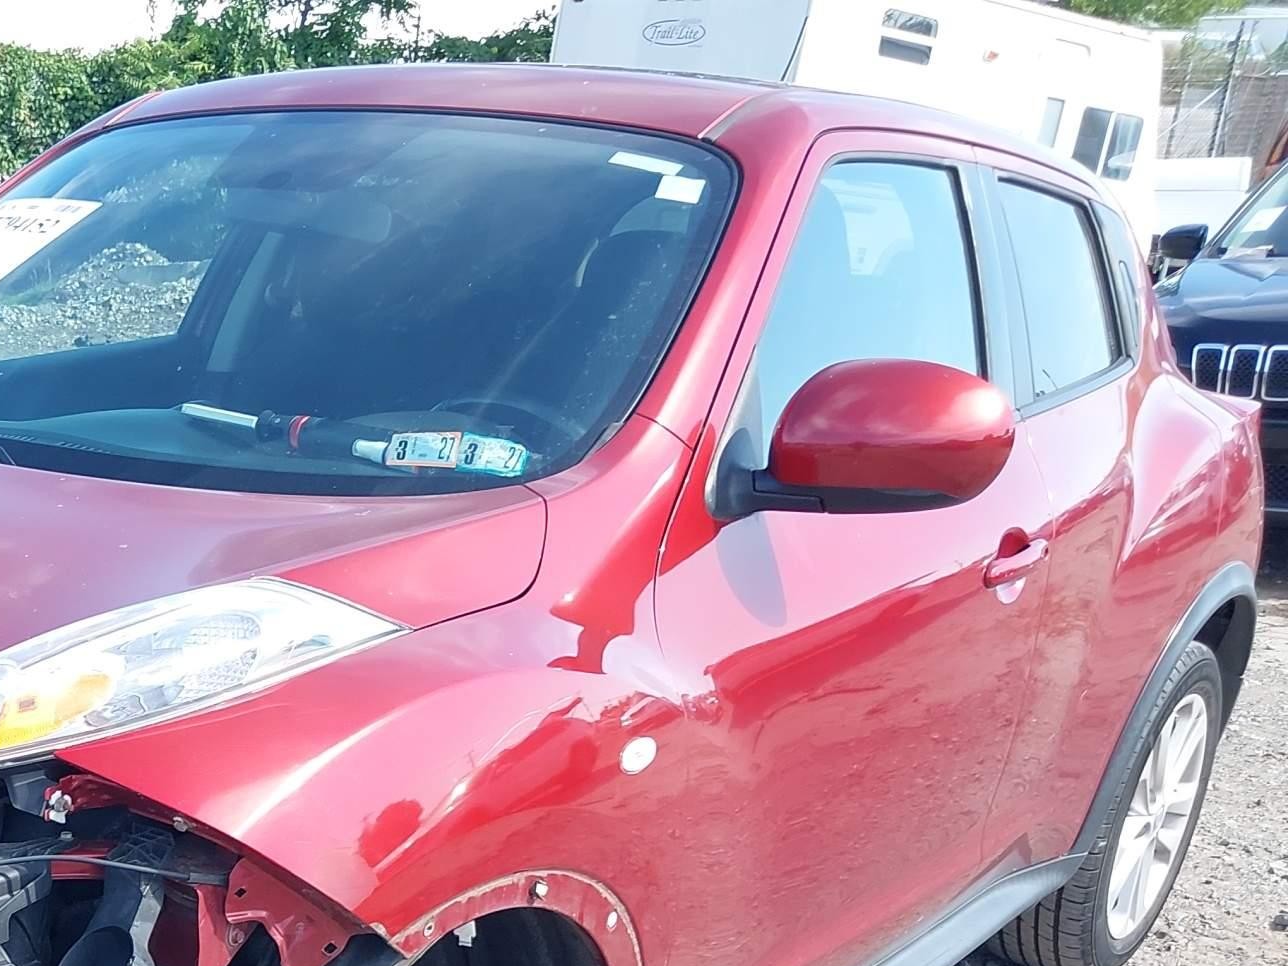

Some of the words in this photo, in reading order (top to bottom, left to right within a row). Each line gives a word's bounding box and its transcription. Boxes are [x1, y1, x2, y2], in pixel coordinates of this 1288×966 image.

[396, 439, 408, 461] 3
[437, 436, 456, 462] 27
[464, 443, 478, 465] 3
[503, 446, 523, 472] 27
